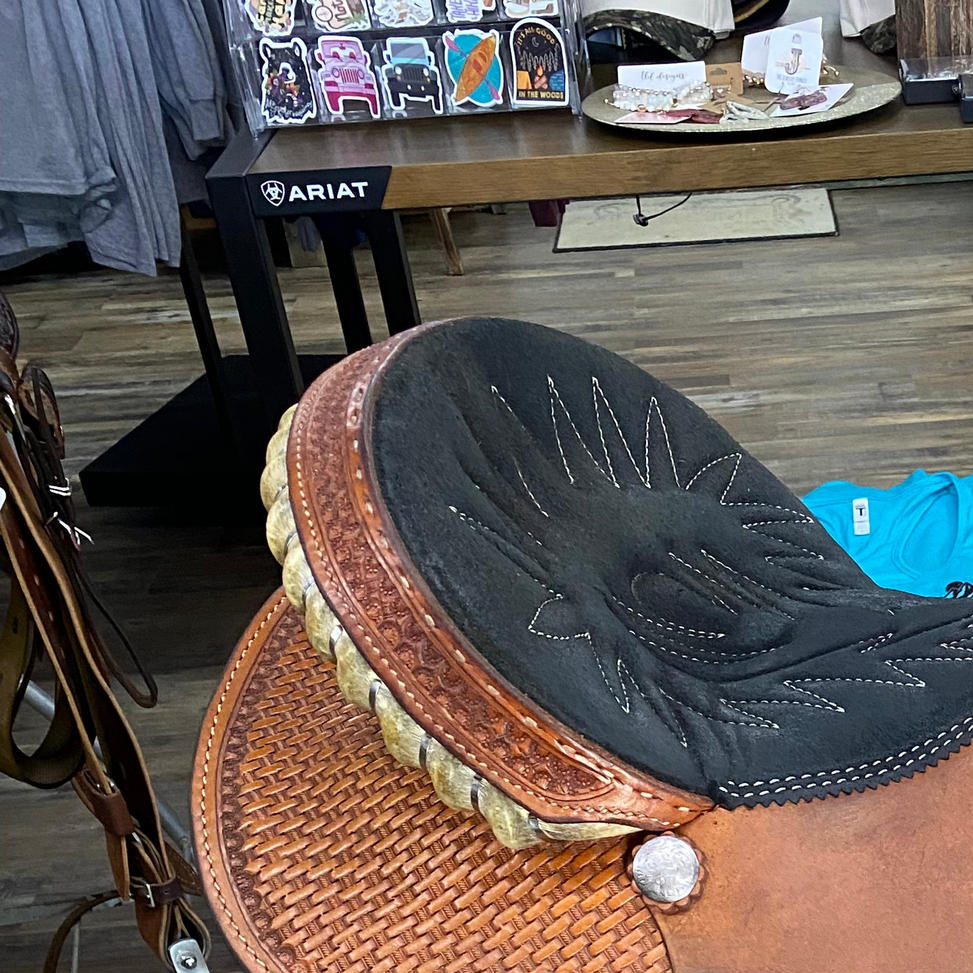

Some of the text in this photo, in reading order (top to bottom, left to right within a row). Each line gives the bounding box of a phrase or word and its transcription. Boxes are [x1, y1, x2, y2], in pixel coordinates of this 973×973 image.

[465, 0, 480, 16] HIK
[535, 27, 555, 45] GOOD
[540, 91, 564, 99] WOODS
[289, 182, 369, 202] ARIAT
